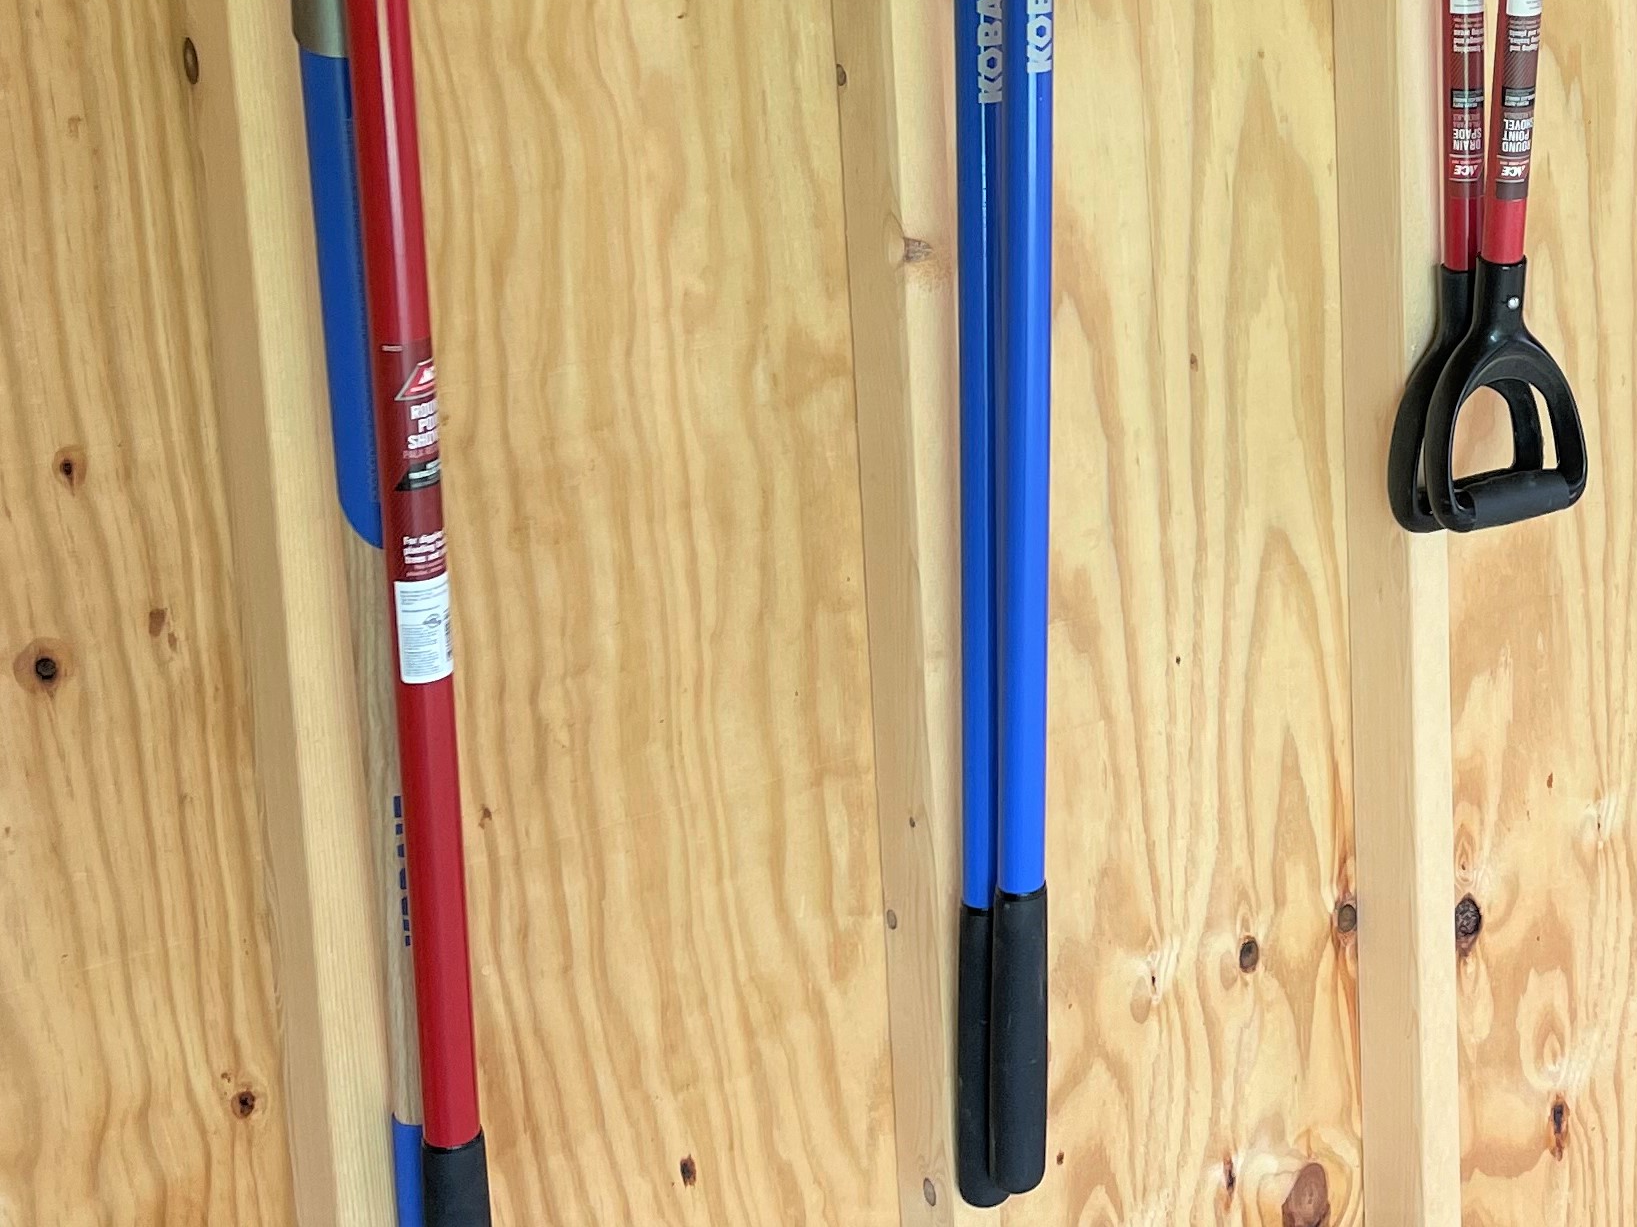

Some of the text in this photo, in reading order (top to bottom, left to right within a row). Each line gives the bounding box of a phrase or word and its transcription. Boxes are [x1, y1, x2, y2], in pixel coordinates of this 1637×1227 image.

[1453, 128, 1481, 139] SPADE
[1501, 129, 1530, 141] POINT
[1453, 140, 1481, 151] DRAIN
[1454, 165, 1478, 176] ACE
[1500, 165, 1526, 177] ACE
